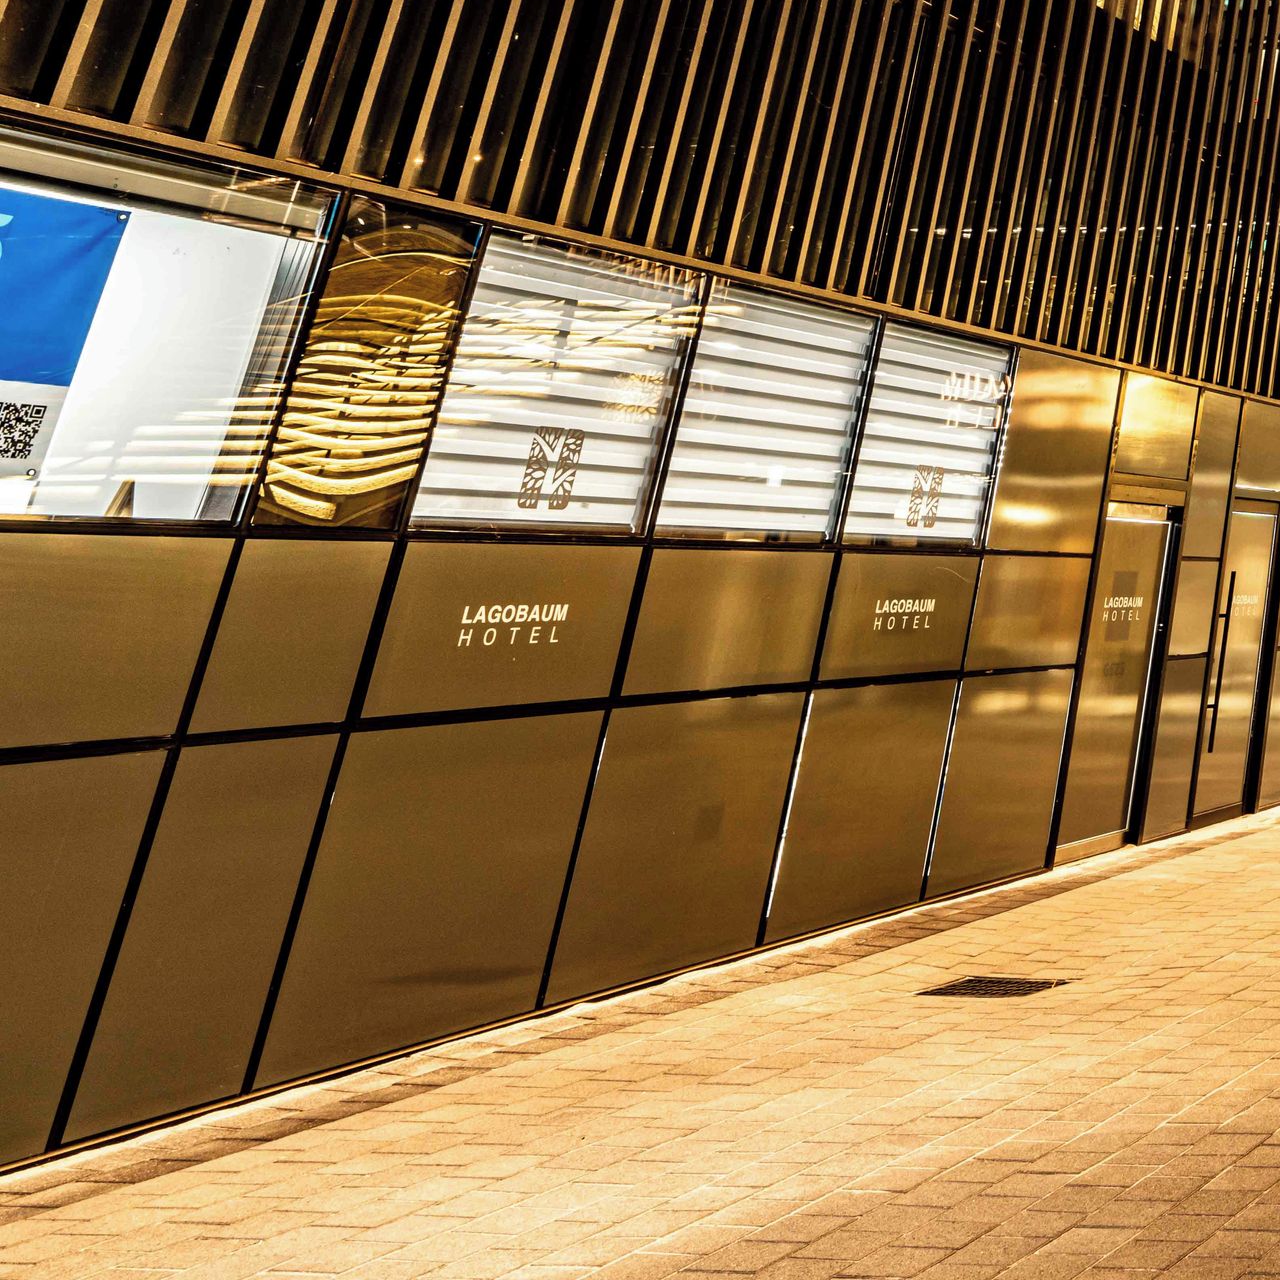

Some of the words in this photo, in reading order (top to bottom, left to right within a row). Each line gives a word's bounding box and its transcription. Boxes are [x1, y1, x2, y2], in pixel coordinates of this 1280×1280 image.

[874, 598, 936, 614] LAGOBAUM
[1103, 596, 1144, 609] LAGOBAUM
[461, 603, 570, 624] LAGOBAUM
[1102, 609, 1141, 622] HOTEL
[873, 615, 931, 631] HOTEL
[457, 625, 560, 648] HOTEL
